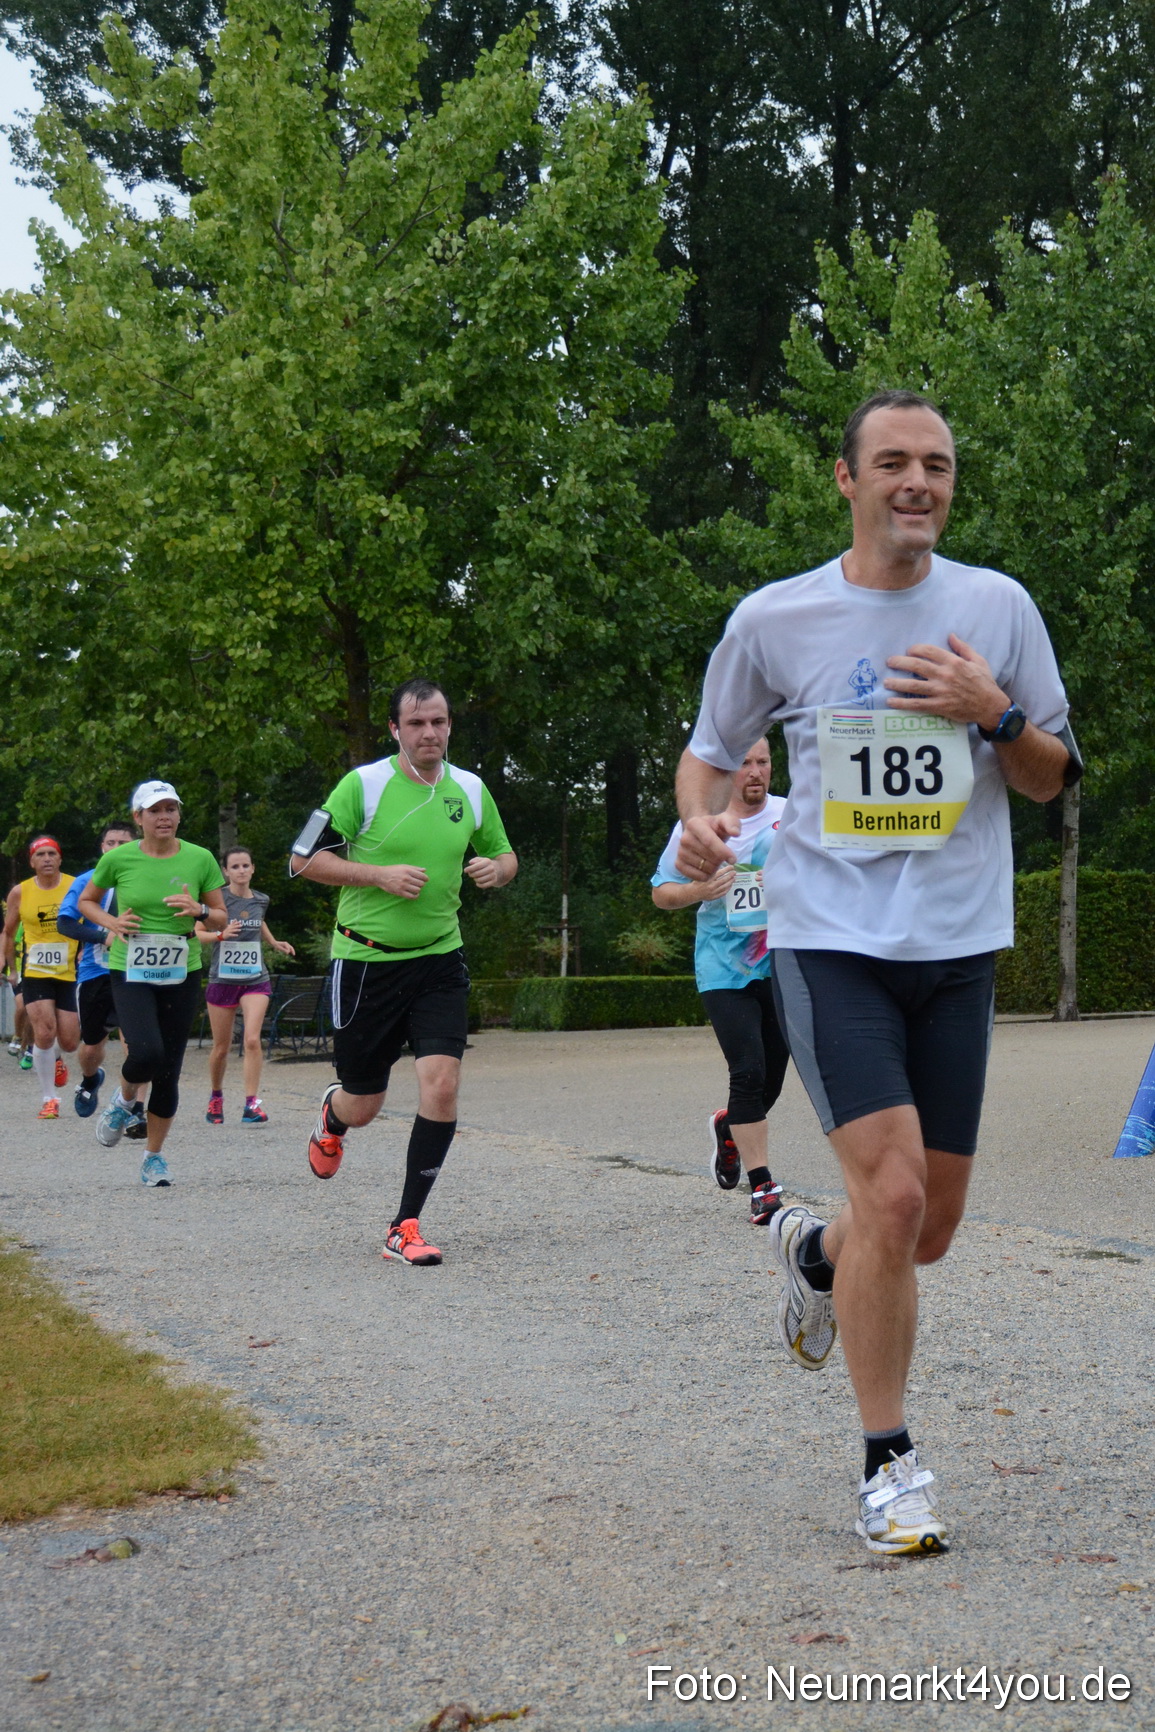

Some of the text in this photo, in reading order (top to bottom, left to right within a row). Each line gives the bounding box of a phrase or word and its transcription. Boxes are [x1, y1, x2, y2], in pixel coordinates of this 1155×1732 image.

[829, 726, 876, 735] NeuerMarkt
[850, 745, 944, 797] 183
[853, 810, 941, 830] Bernhard
[733, 886, 764, 910] 20
[37, 951, 62, 965] 209
[133, 946, 184, 966] 2527
[224, 950, 258, 965] 2229
[143, 970, 172, 978] Claudia
